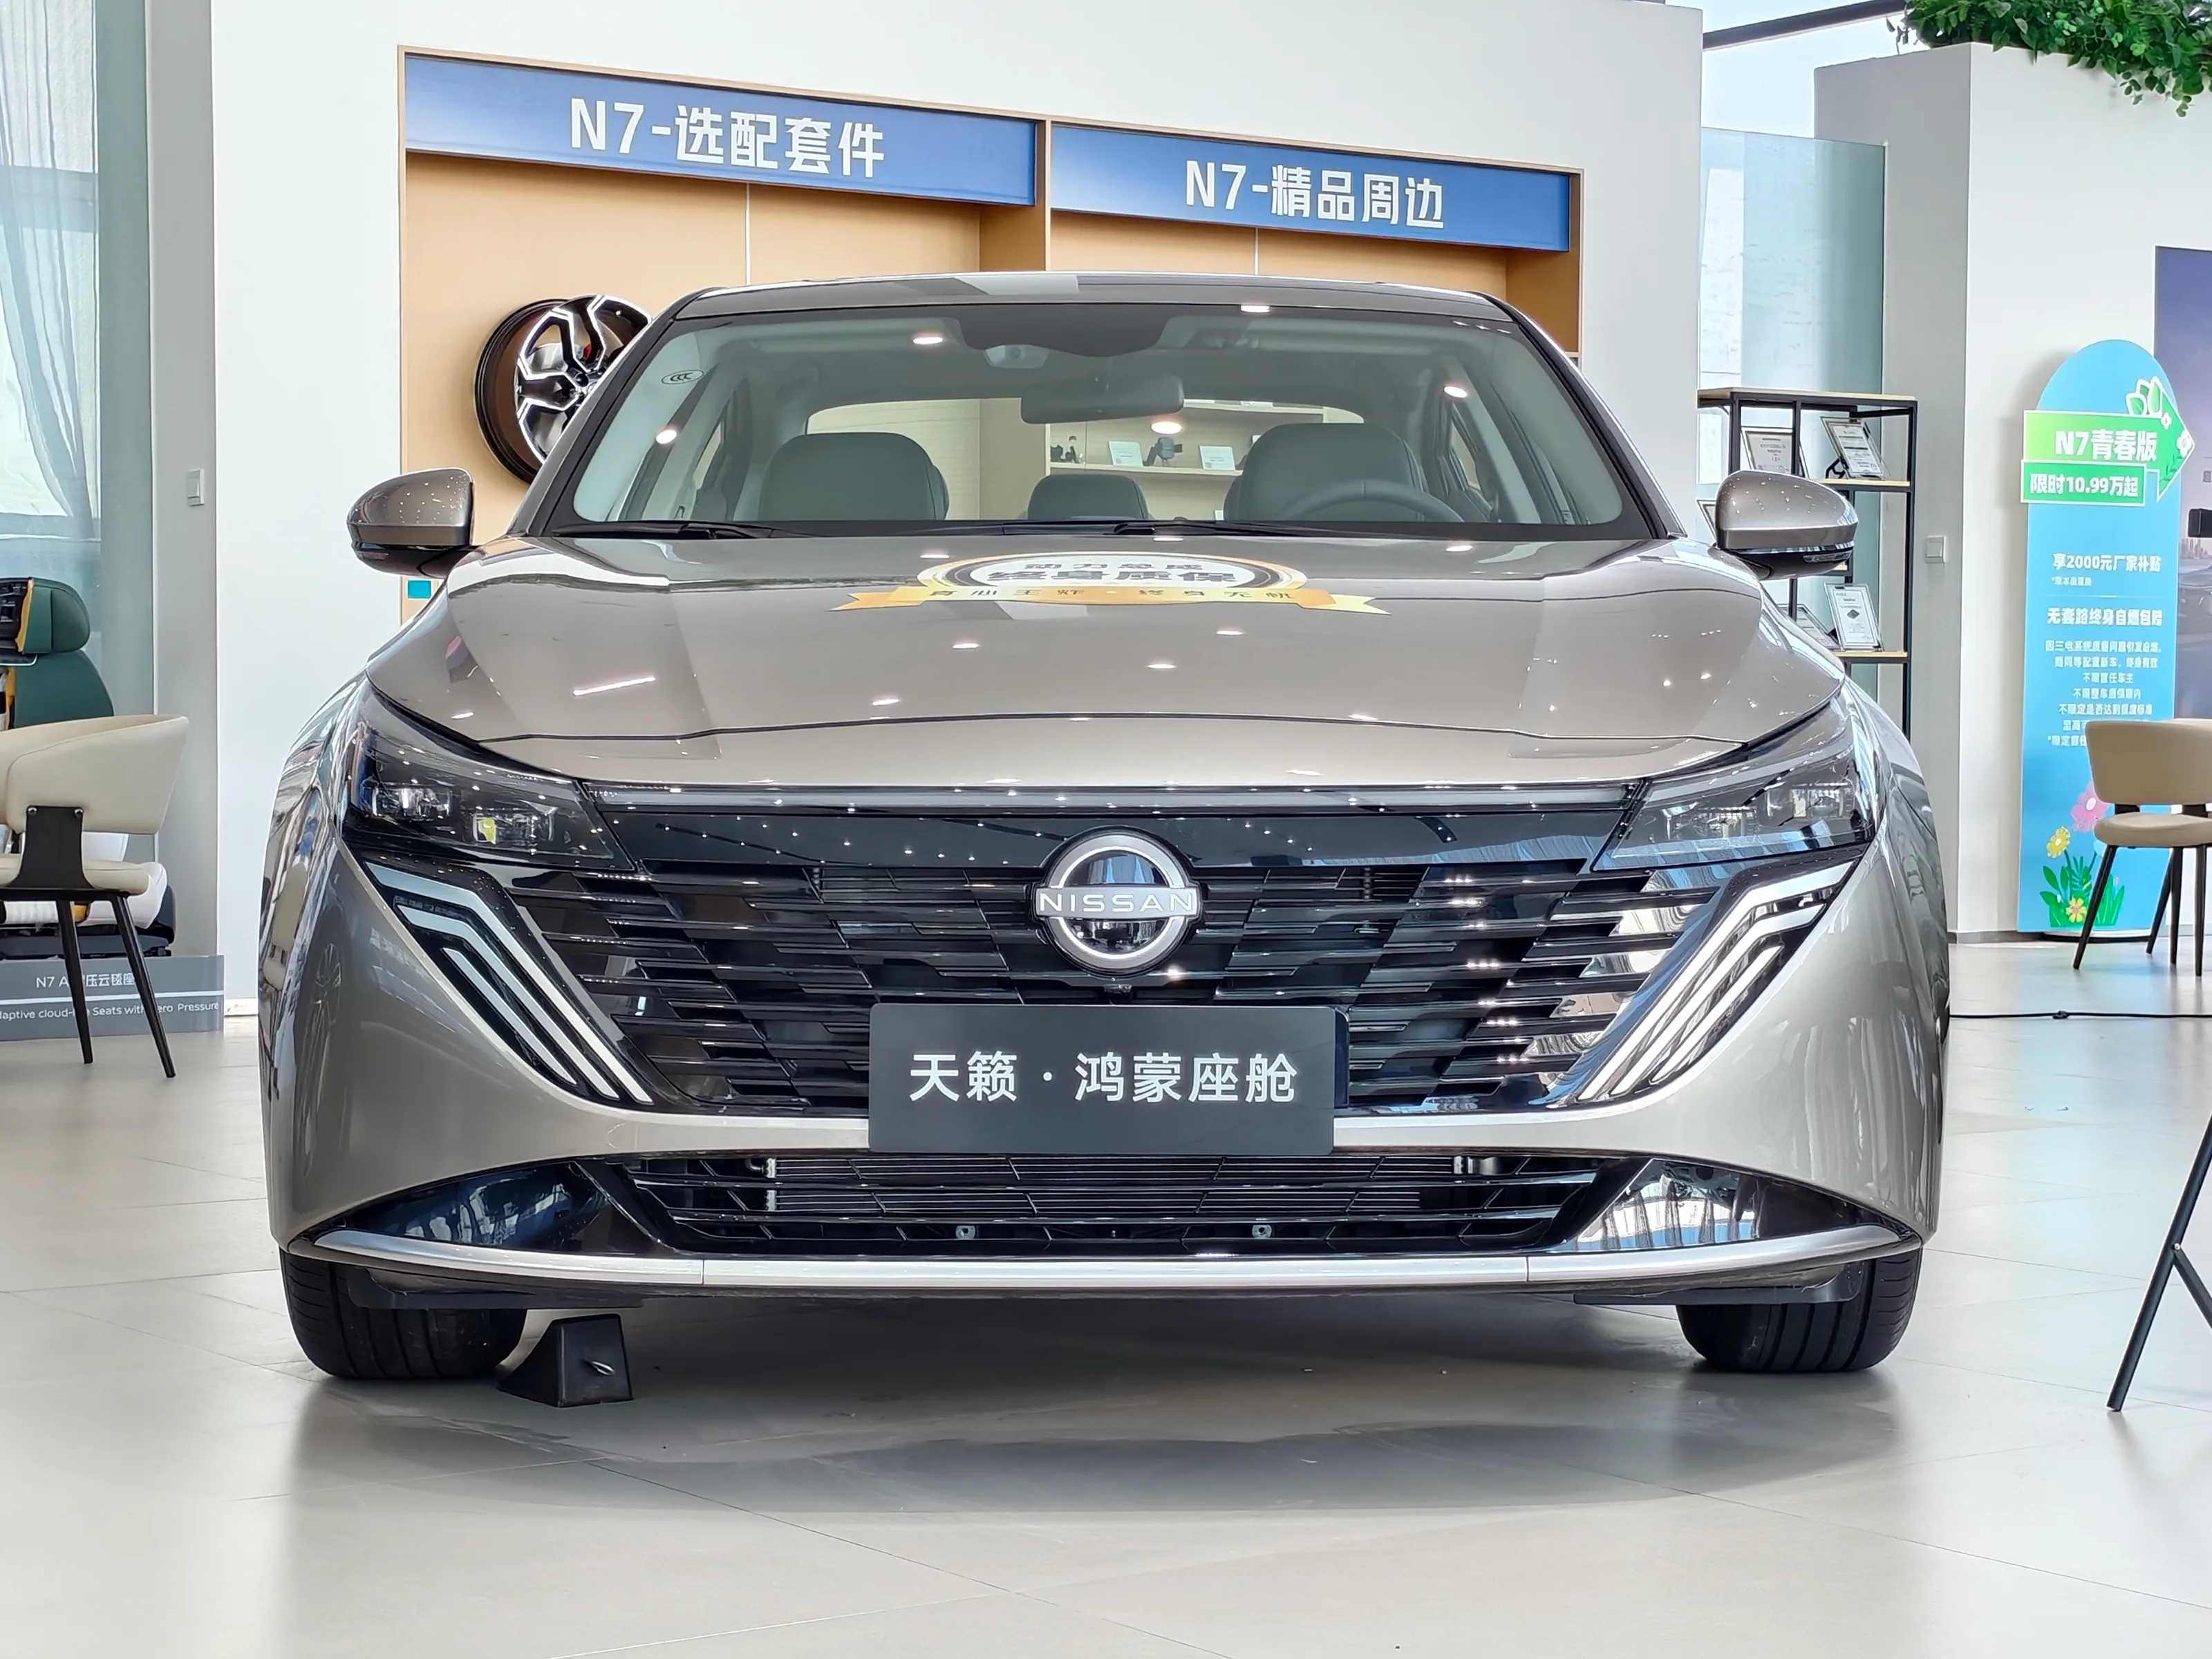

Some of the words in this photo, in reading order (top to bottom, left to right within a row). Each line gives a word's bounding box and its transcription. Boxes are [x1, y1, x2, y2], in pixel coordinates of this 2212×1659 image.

[570, 97, 884, 177] N7-选配套件
[1185, 160, 1444, 229] N7-精品周边
[2054, 428, 2157, 462] N7青春版
[2030, 473, 2139, 497] 限时10.99万起
[987, 570, 1237, 582] 终身质保
[1040, 893, 1192, 912] NISSAN
[36, 976, 55, 988] N7
[0, 1011, 35, 1022] aptive
[93, 1007, 122, 1016] Seats
[158, 1004, 174, 1013] ero
[178, 1002, 219, 1012] Pressure
[909, 1051, 1297, 1103] 天籁·鸿蒙座舱
